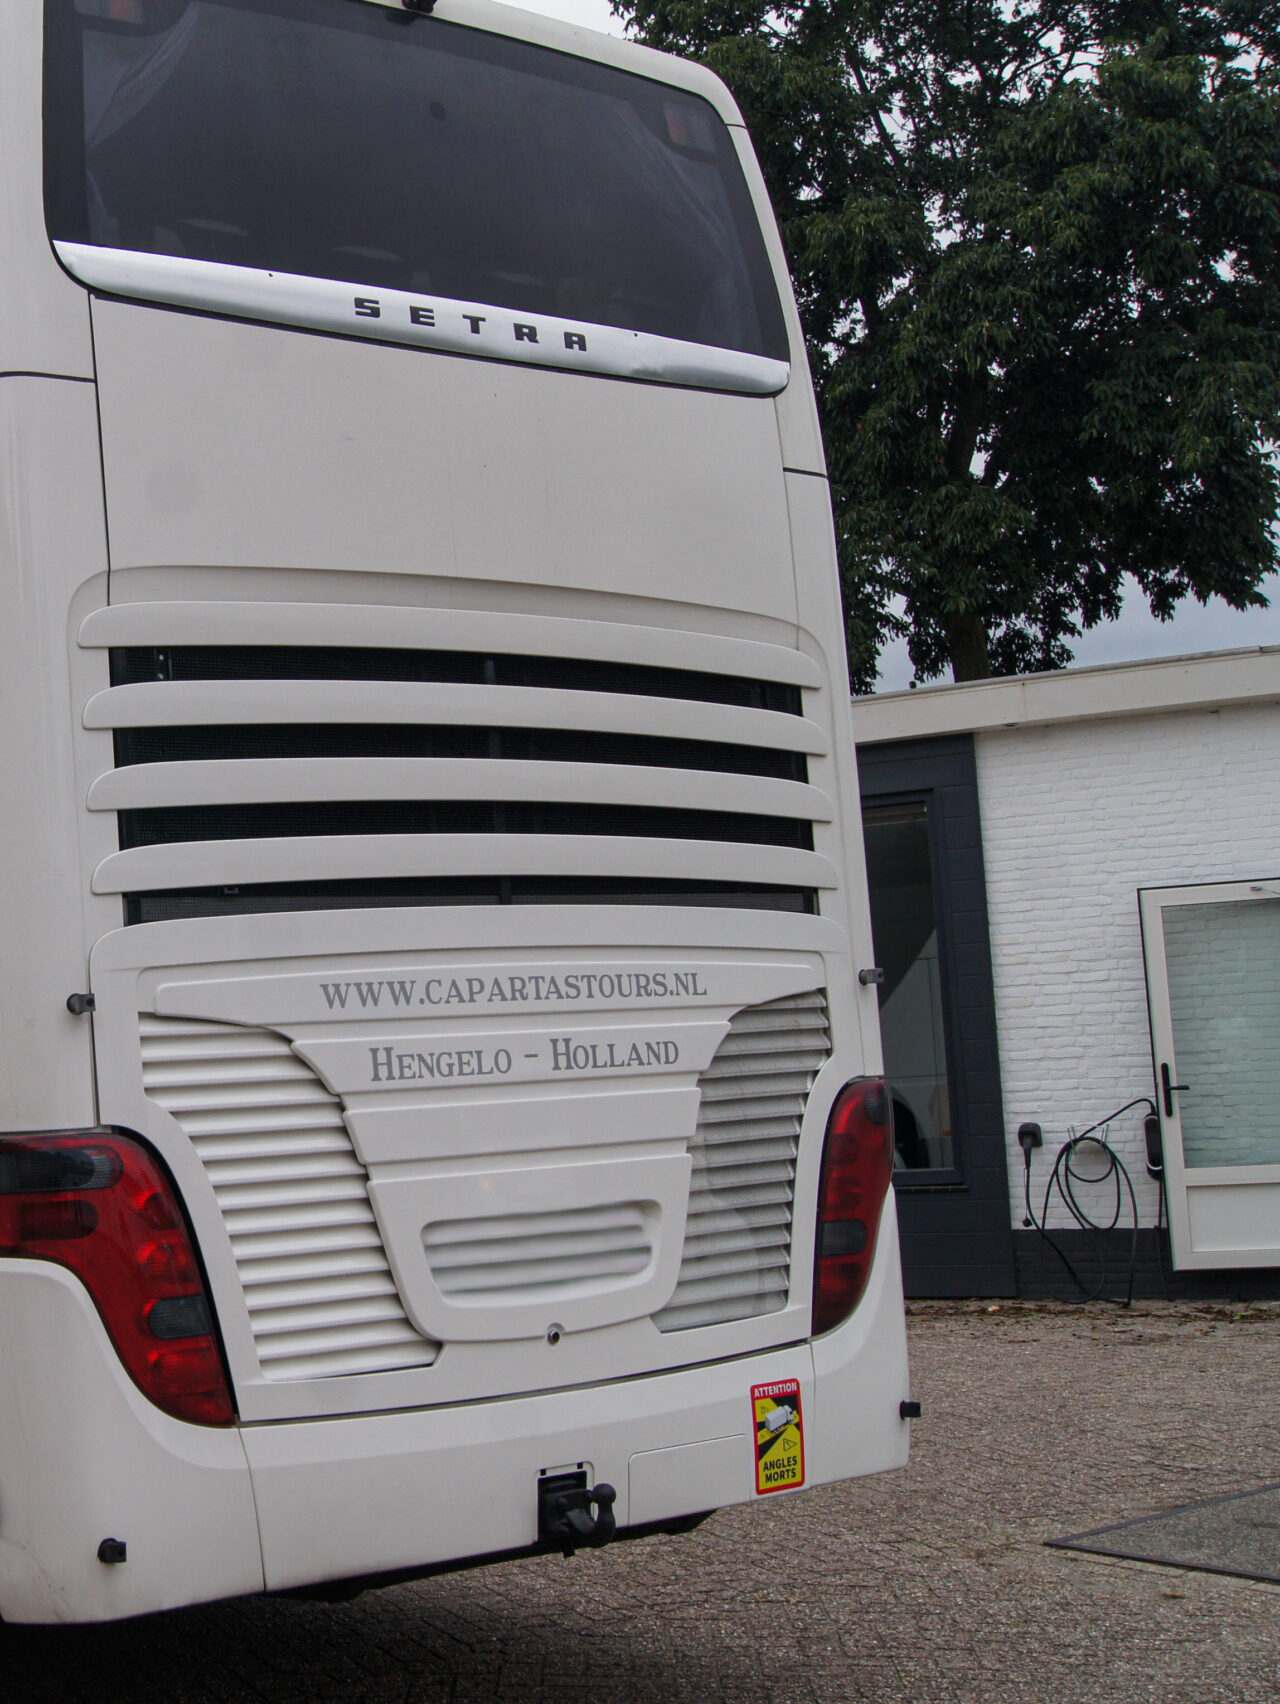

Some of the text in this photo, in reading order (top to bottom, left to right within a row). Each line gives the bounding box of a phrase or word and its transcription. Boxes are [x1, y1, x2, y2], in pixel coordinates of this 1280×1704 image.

[353, 296, 588, 352] SETRA
[319, 972, 708, 1009] WWW.CAPARTASTOURS.NL
[368, 1046, 513, 1082] HENGELO
[549, 1037, 680, 1071] HOLLAND
[754, 1381, 798, 1398] ATTENTION
[763, 1455, 798, 1473] ANGLES
[765, 1467, 797, 1484] MORTS
